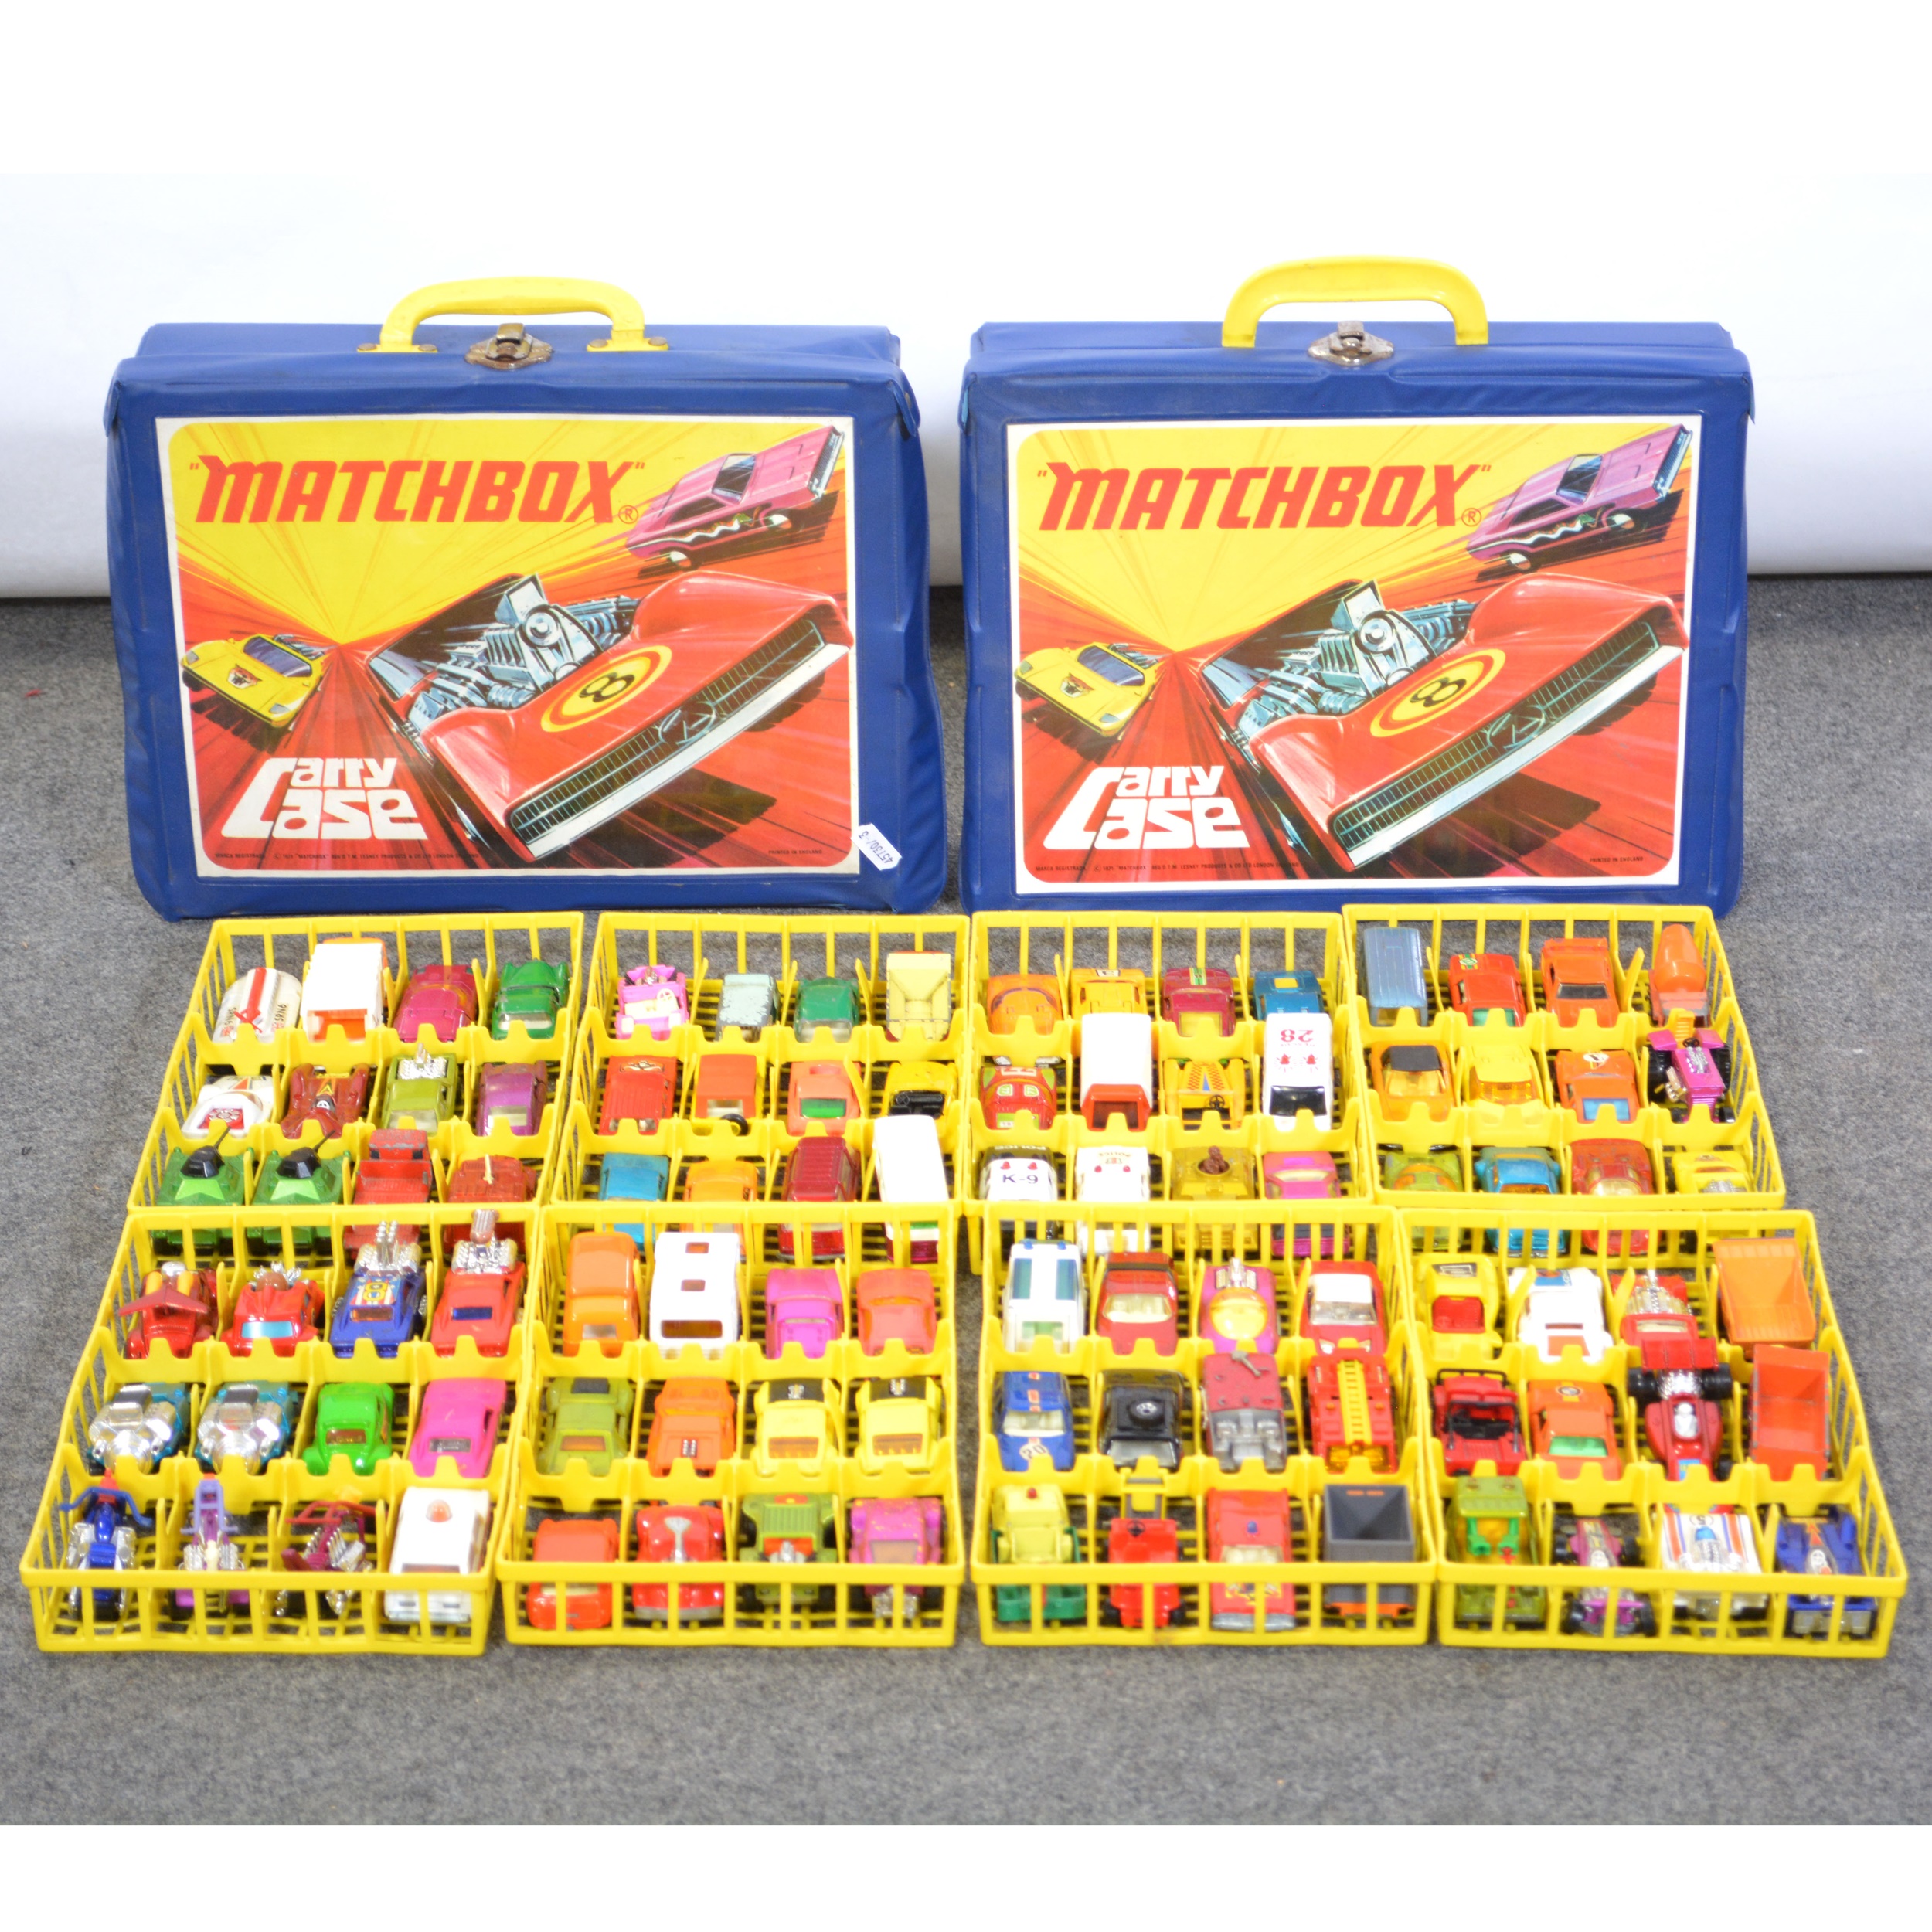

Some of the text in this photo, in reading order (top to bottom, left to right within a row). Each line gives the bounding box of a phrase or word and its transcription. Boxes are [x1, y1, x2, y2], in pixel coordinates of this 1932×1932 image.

[1280, 1029, 1314, 1043] 28
[1002, 1174, 1039, 1184] K-9
[362, 1281, 389, 1302] 8
